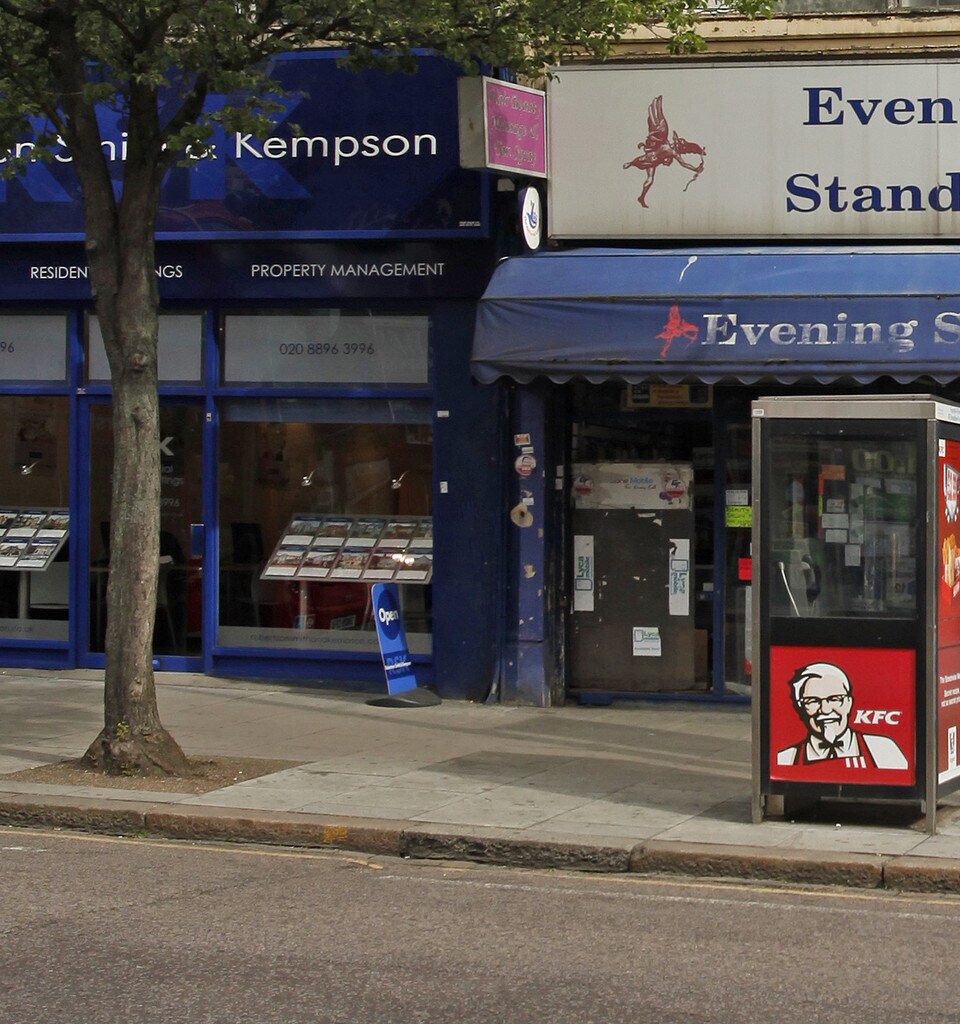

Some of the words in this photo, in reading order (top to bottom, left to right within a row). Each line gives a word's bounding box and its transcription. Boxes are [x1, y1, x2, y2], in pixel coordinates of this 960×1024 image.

[235, 131, 438, 167] Kempson
[251, 263, 325, 278] PROPERTY
[331, 262, 445, 278] MANAGEMENT
[701, 313, 919, 354] Evening
[279, 343, 304, 356] 020
[307, 342, 339, 356] 8896
[343, 342, 375, 356] 3996
[378, 607, 399, 626] Open
[853, 710, 901, 725] KFC
